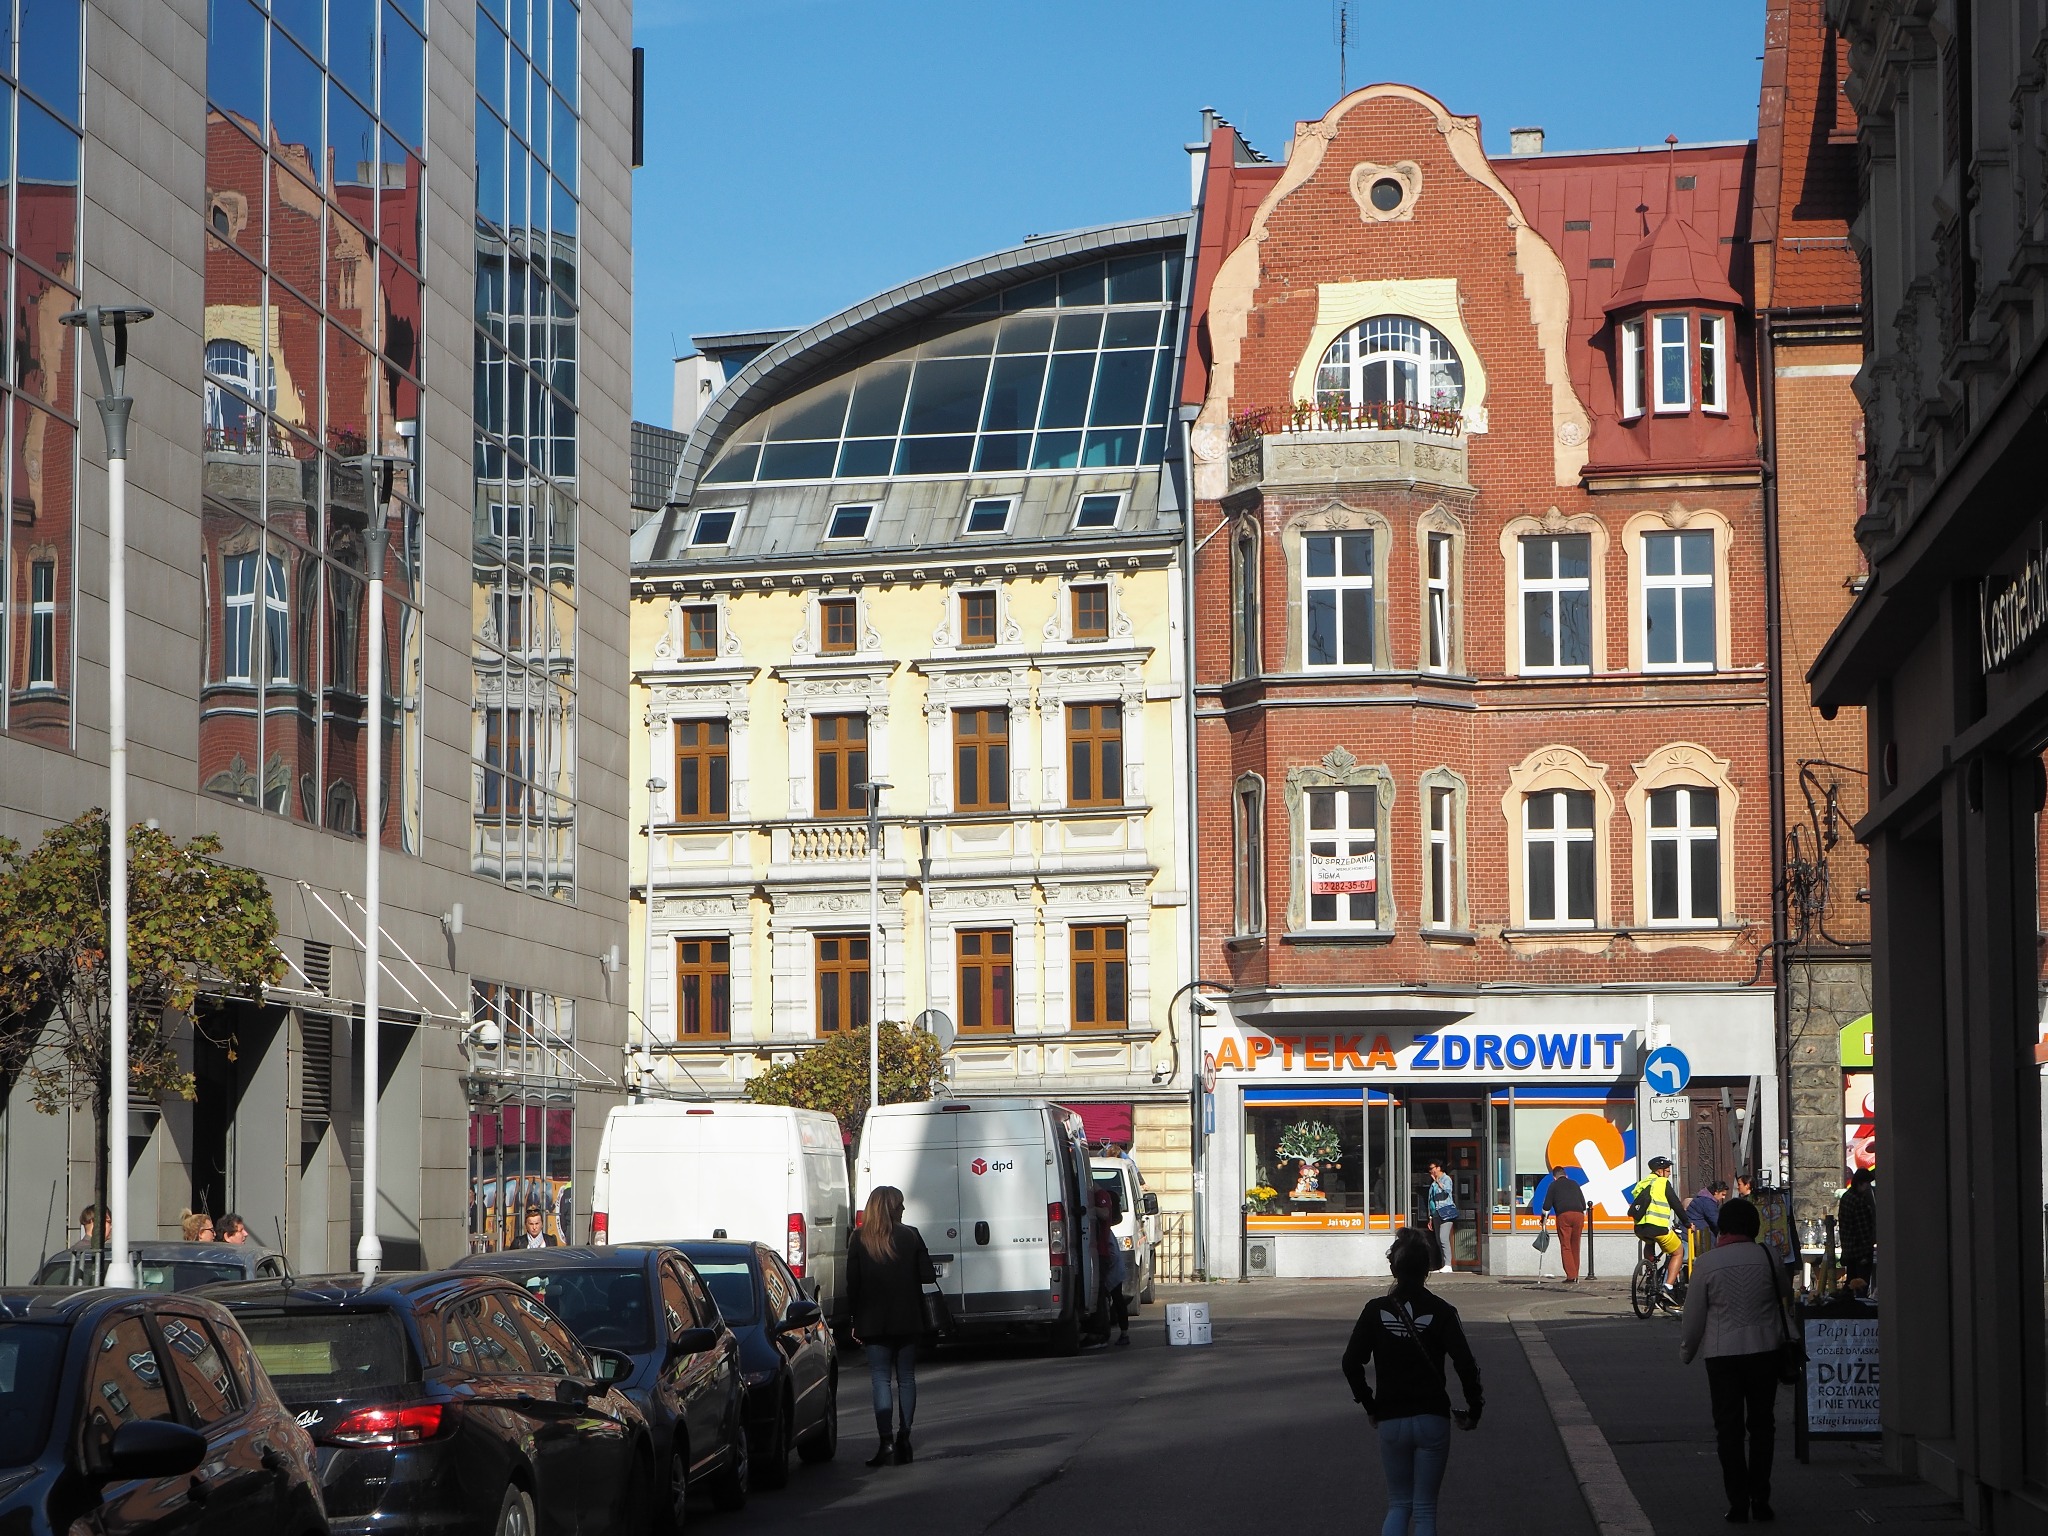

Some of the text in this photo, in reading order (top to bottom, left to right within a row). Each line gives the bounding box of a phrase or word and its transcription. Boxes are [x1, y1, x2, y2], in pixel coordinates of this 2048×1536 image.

[1312, 854, 1375, 866] DO SPRZEDANIA
[1319, 881, 1370, 890] 32 282-35-67
[1215, 1033, 1624, 1071] APTEKA ZDROWIT
[991, 1160, 1013, 1172] dpd
[1351, 1218, 1361, 1226] 20
[1546, 1218, 1555, 1226] 20
[1817, 1323, 1848, 1341] Papi
[1816, 1346, 1844, 1355] ODZIEŻ
[1818, 1358, 1880, 1384] DUŻE
[1818, 1386, 1880, 1397] ROZMIARY
[1818, 1400, 1880, 1409] I NIE TYLKO
[1811, 1416, 1840, 1428] Usługi
